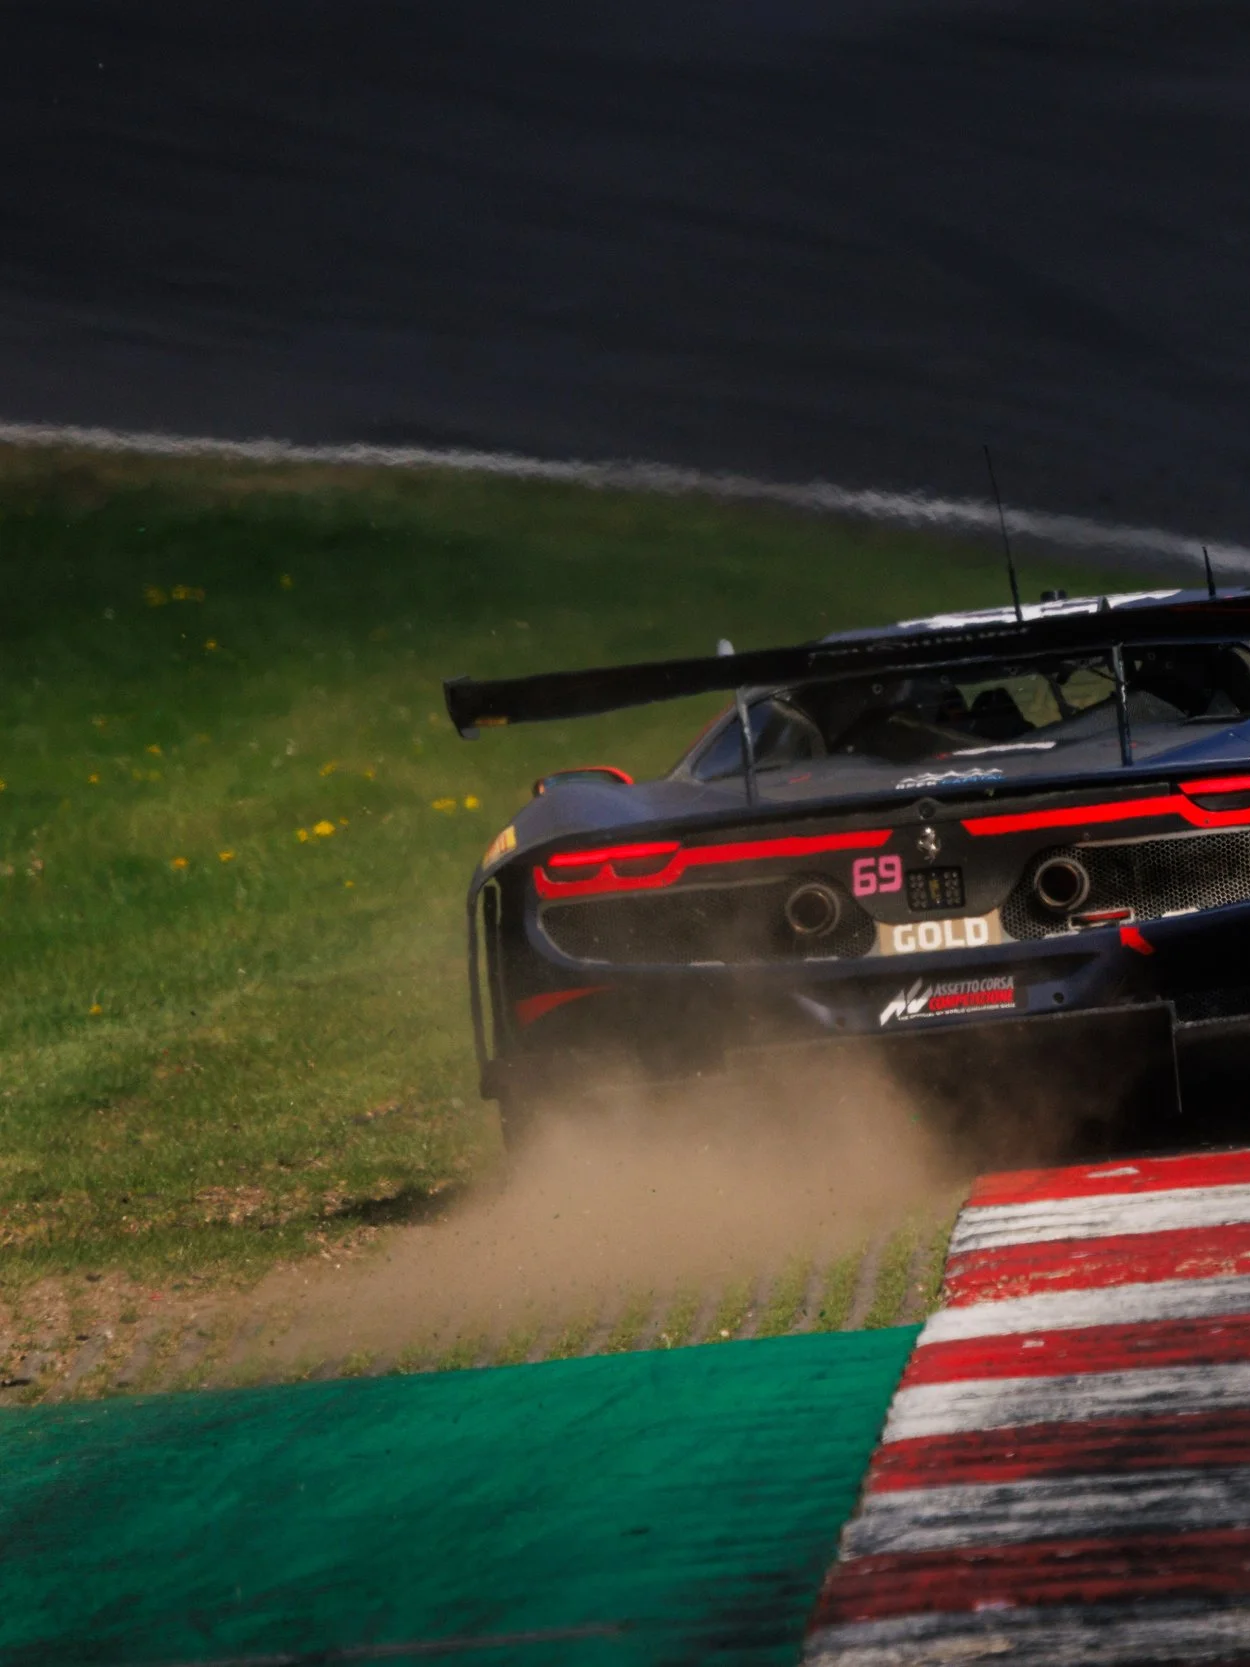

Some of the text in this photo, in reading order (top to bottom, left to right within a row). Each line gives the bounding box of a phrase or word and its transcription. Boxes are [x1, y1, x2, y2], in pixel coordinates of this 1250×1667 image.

[853, 854, 902, 897] 69
[893, 916, 989, 953] GOLD
[932, 975, 1015, 997] ASSETTO CORSA
